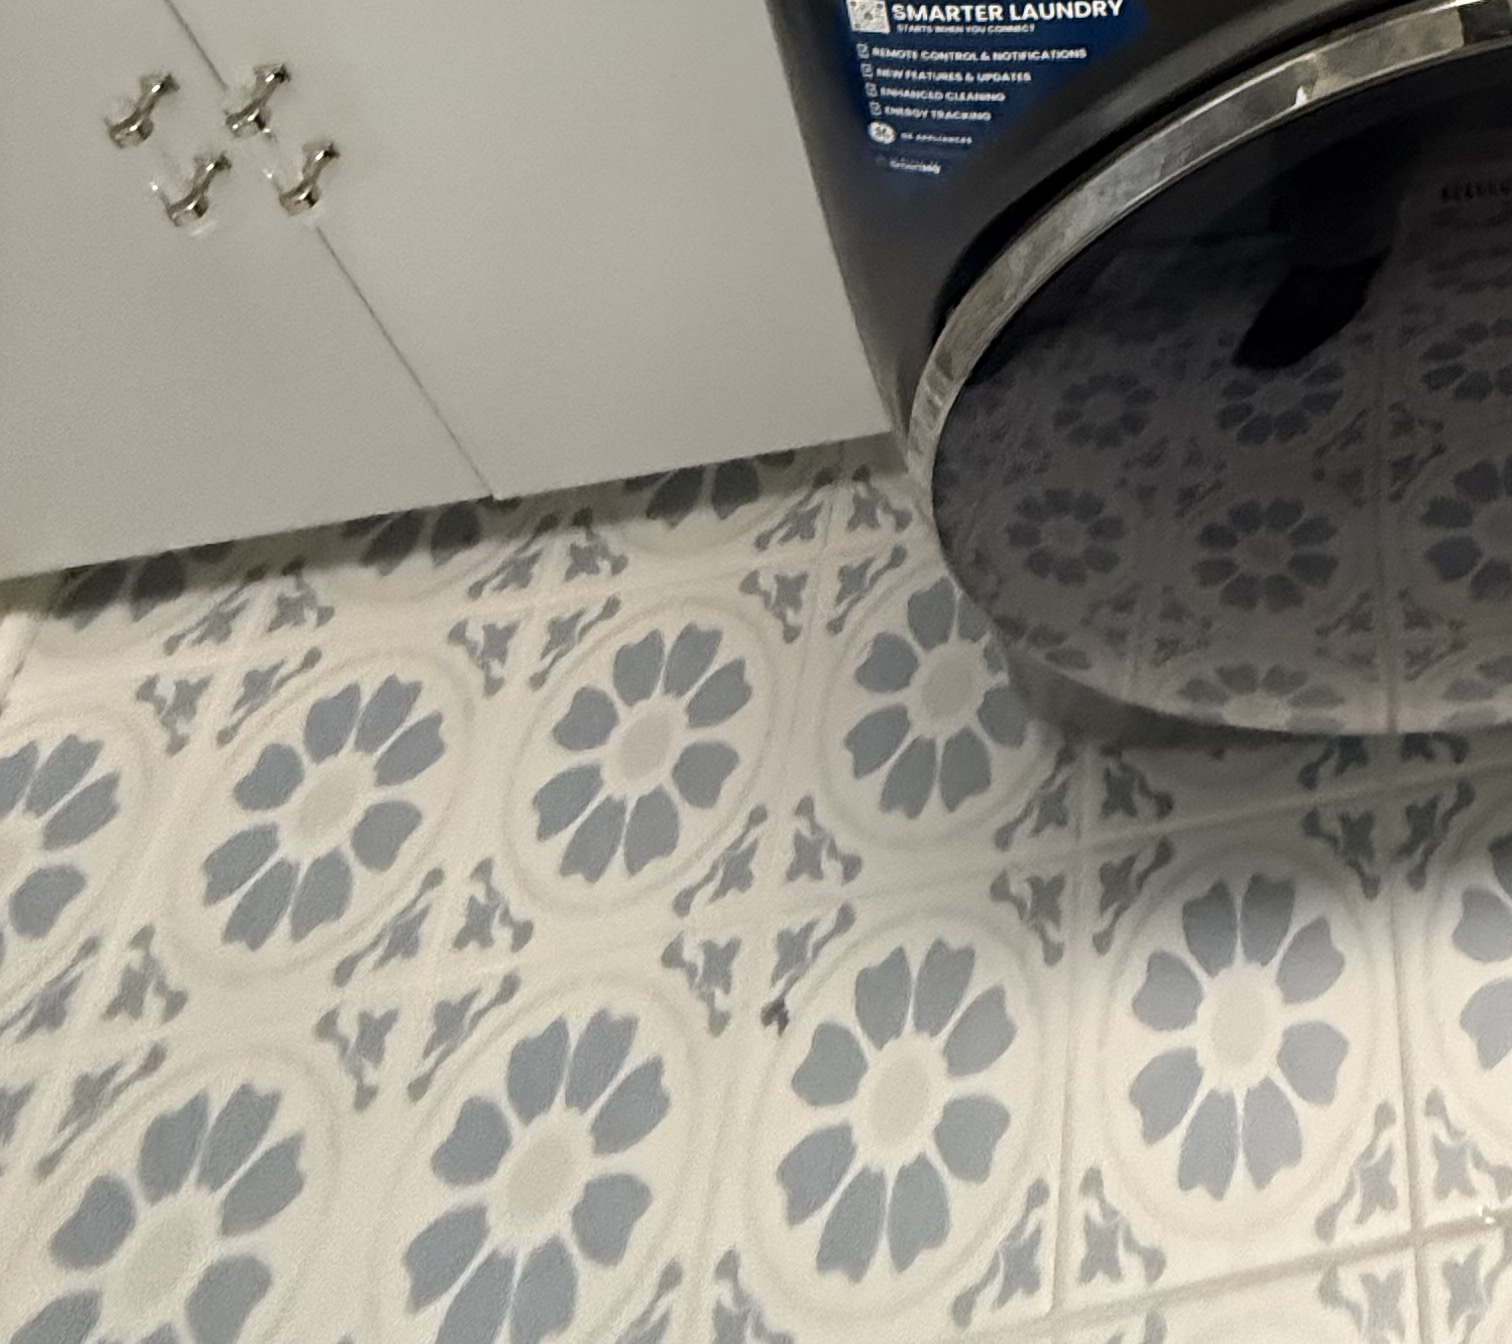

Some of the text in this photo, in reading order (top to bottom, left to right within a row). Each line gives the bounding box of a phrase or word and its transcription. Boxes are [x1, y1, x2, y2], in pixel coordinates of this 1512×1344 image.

[891, 3, 1004, 22] SMARTER
[965, 24, 986, 34] YOU
[872, 47, 1087, 61] REMOTE CONTROL & NOTIFICATIONS
[876, 67, 1032, 83] NEW FEATURES & UPDATES
[880, 87, 1006, 103] ENHANCED CLEANING
[884, 105, 992, 122] ENERGY TRACKING
